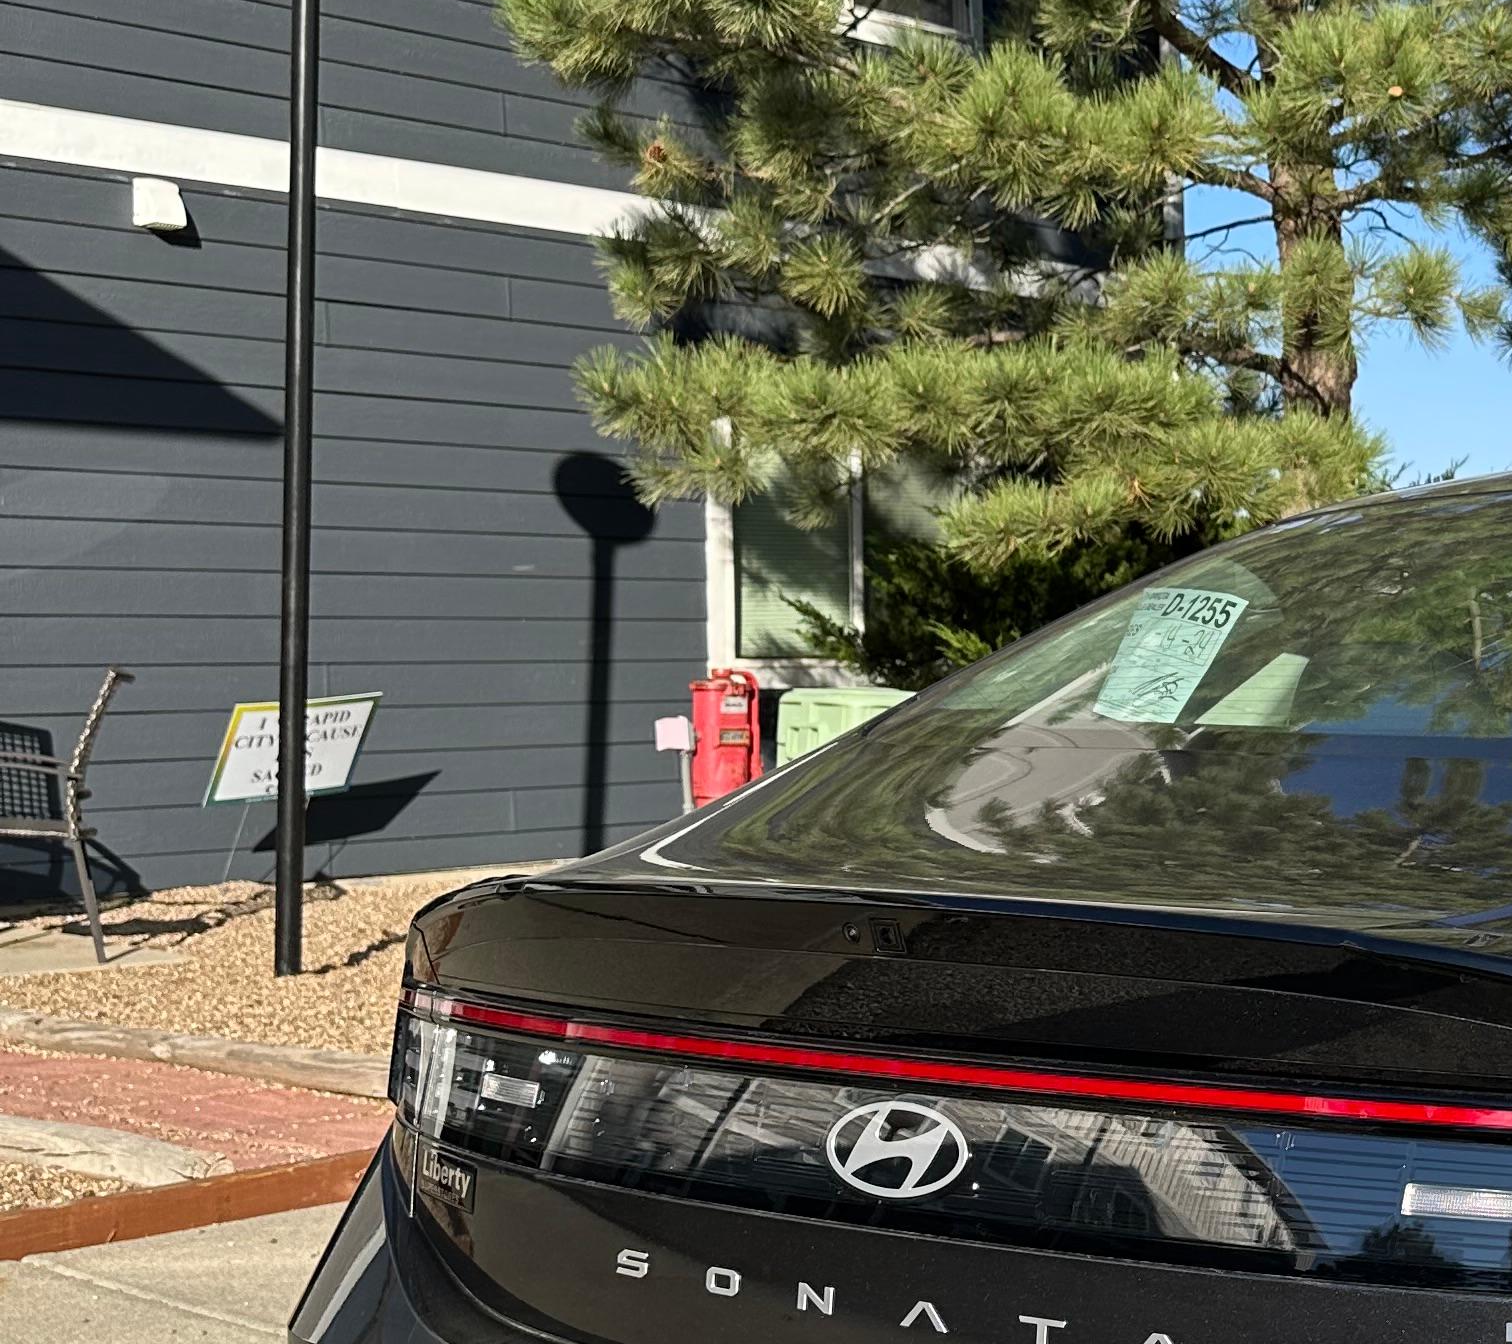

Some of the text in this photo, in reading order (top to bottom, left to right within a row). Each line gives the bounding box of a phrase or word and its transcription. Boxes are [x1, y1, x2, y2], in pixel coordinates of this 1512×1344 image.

[1161, 593, 1238, 629] D-1255
[307, 710, 351, 726] APID
[422, 1148, 471, 1198] Liberty
